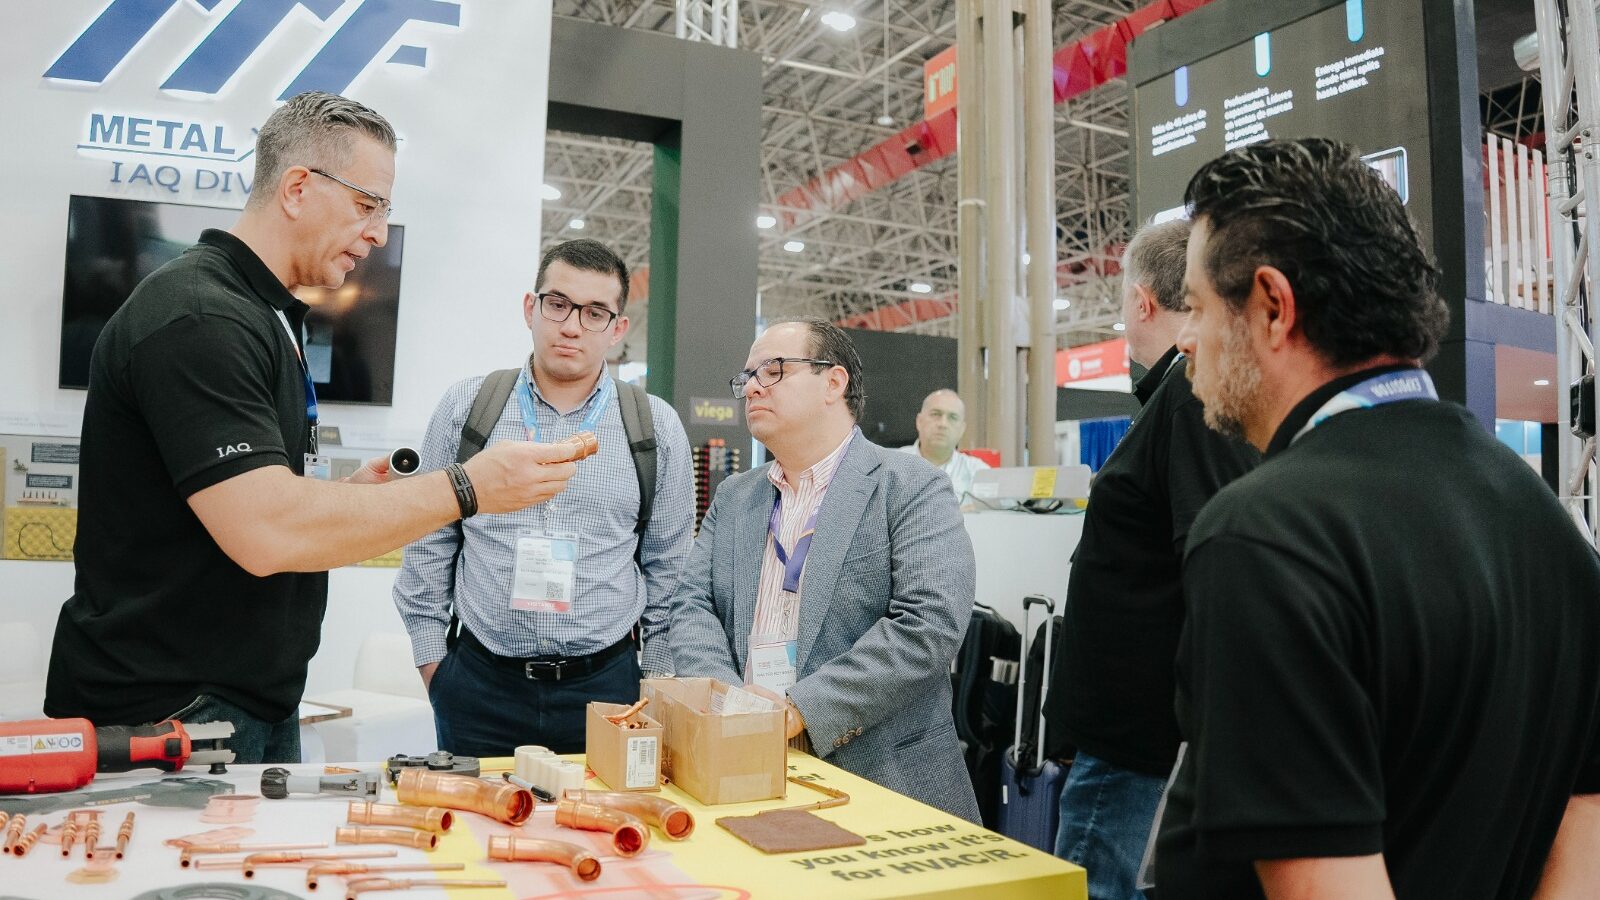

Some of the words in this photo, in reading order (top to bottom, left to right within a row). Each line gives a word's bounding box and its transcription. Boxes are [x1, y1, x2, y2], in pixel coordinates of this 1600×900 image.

[1315, 60, 1344, 77] Entrega
[1345, 47, 1384, 67] inmediata
[1315, 73, 1339, 89] desde
[1339, 66, 1358, 81] mini
[89, 113, 236, 155] METAL
[109, 160, 182, 195] IAQ
[694, 400, 734, 421] viega
[216, 442, 253, 458] IAQ
[886, 823, 957, 841] how
[790, 853, 858, 870] you
[858, 841, 950, 860] know
[950, 833, 1005, 847] it's
[830, 868, 887, 882] for
[889, 848, 1030, 875] HVAC/R.
